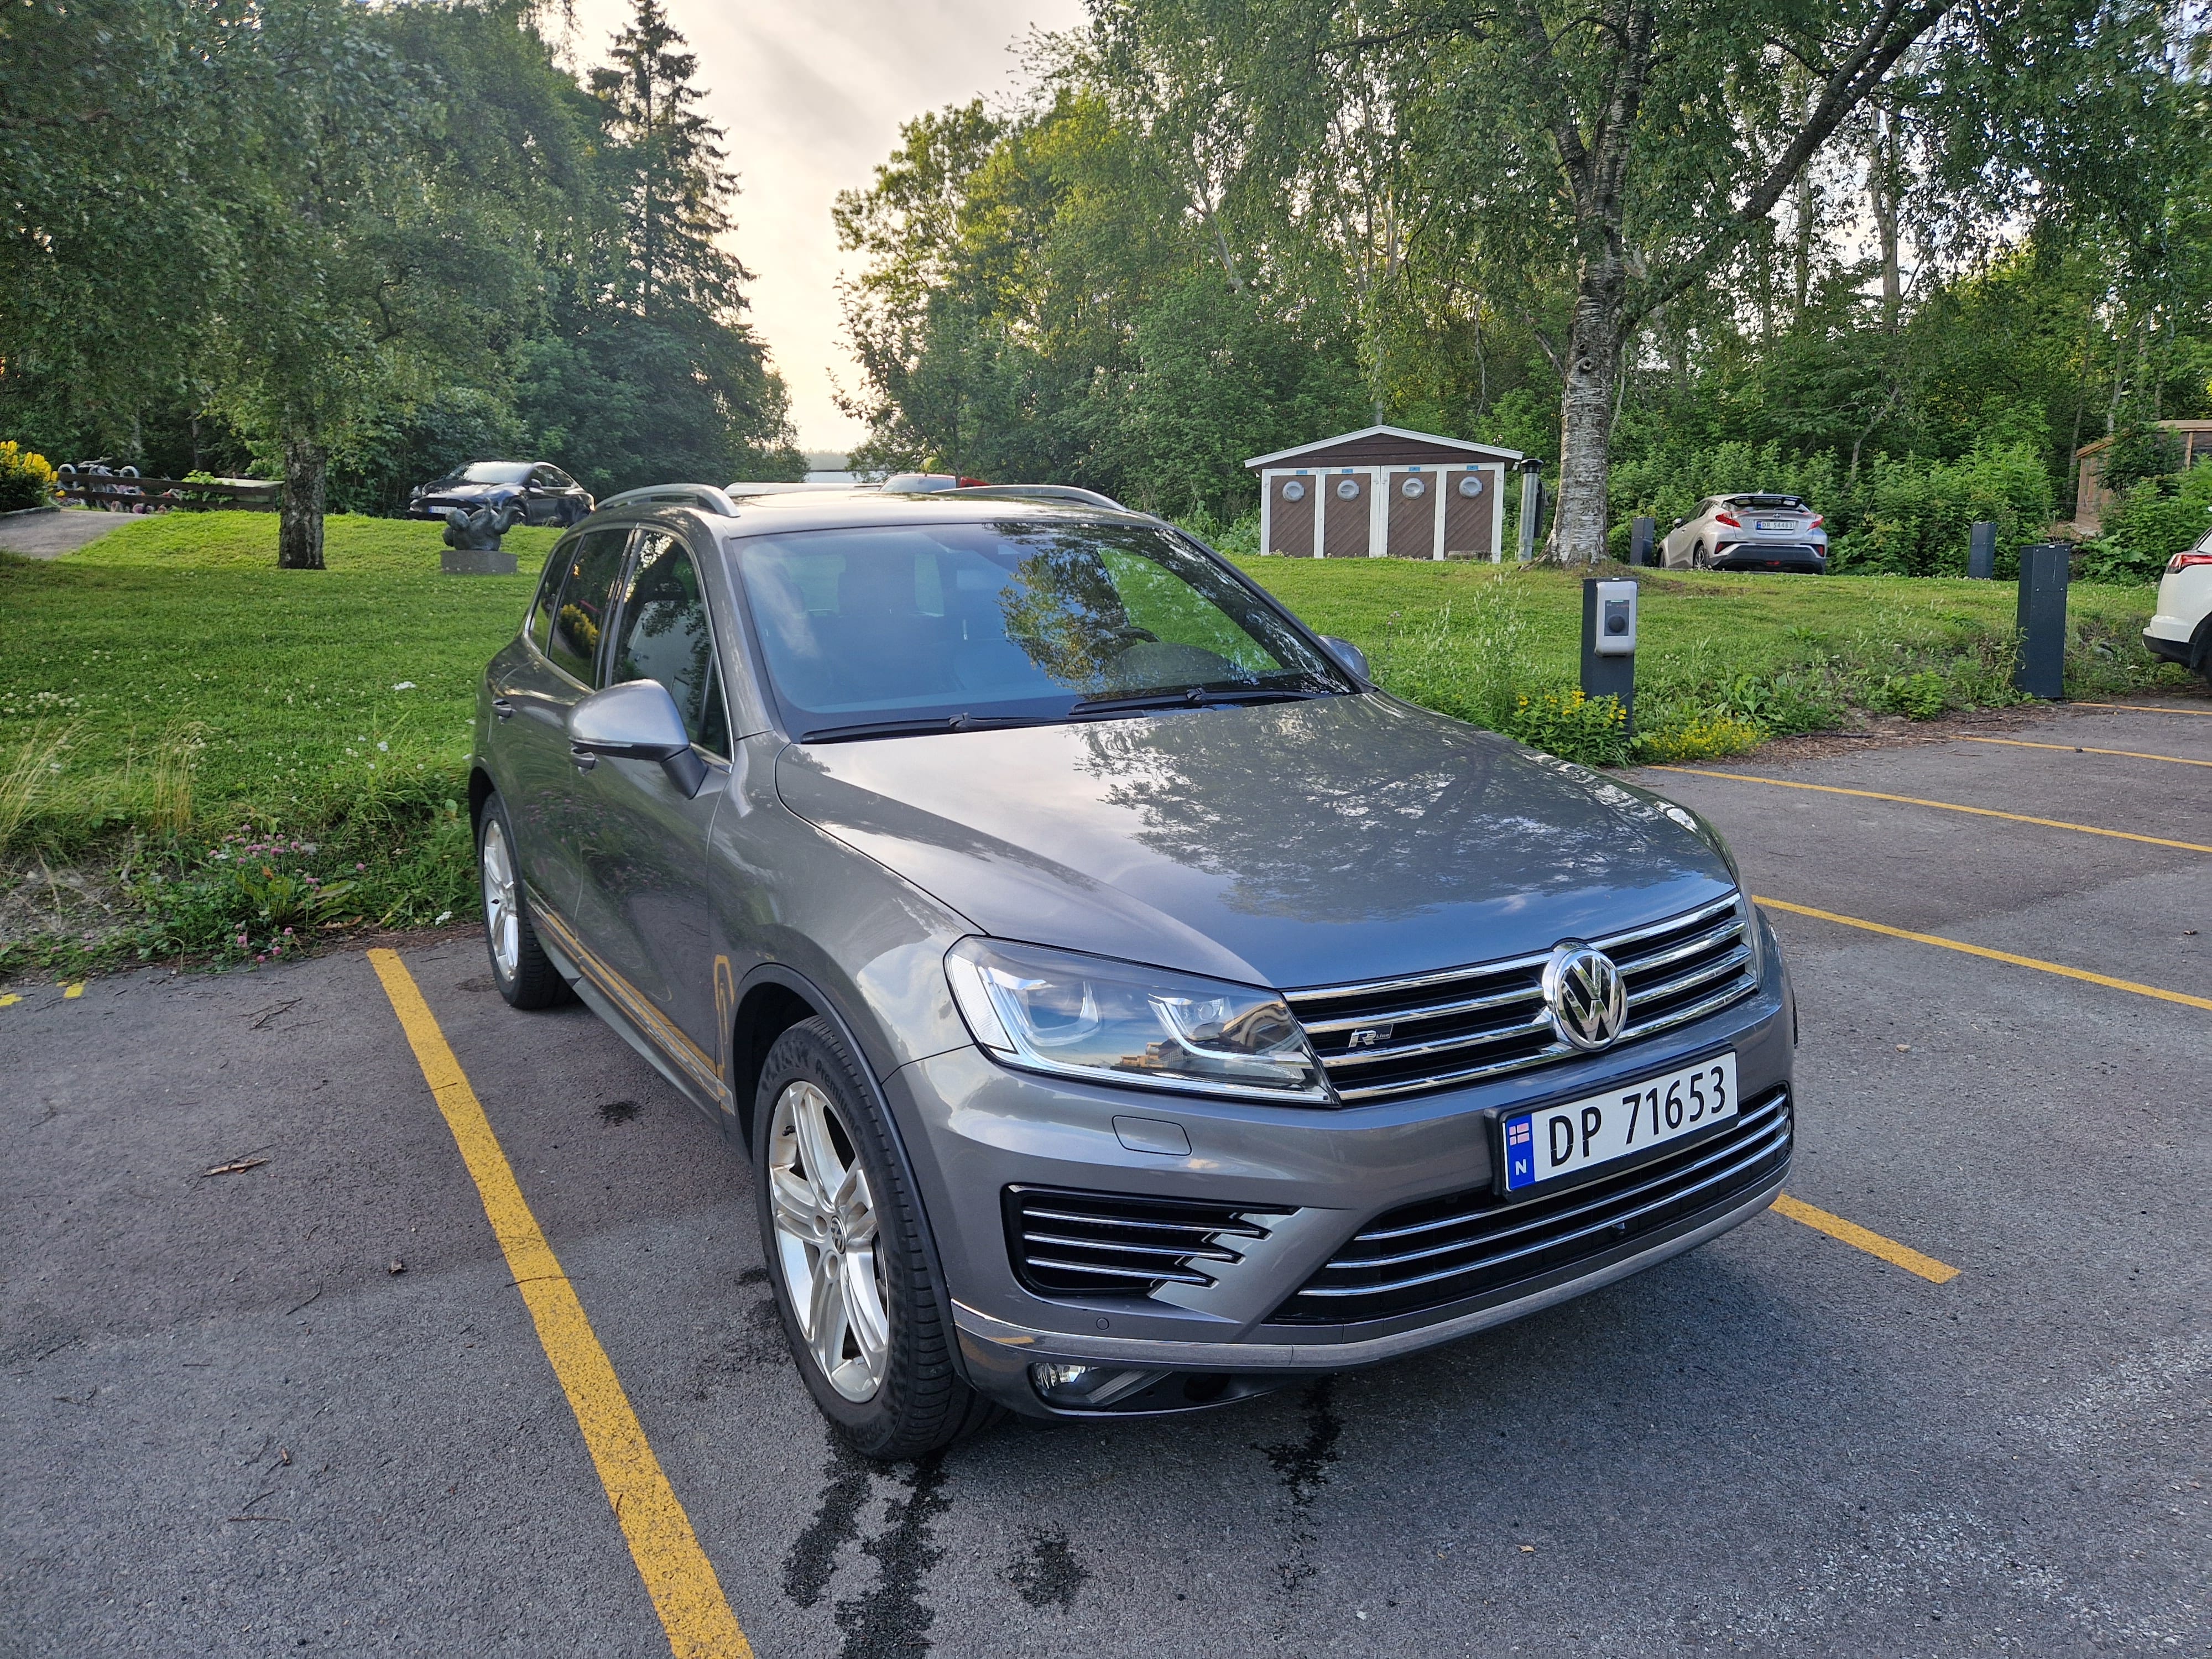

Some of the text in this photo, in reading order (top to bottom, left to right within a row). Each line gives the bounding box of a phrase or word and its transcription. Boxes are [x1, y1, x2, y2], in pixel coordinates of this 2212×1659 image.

[1348, 1030, 1376, 1048] R
[1549, 1066, 1725, 1167] DP 71653
[1515, 1160, 1527, 1176] N
